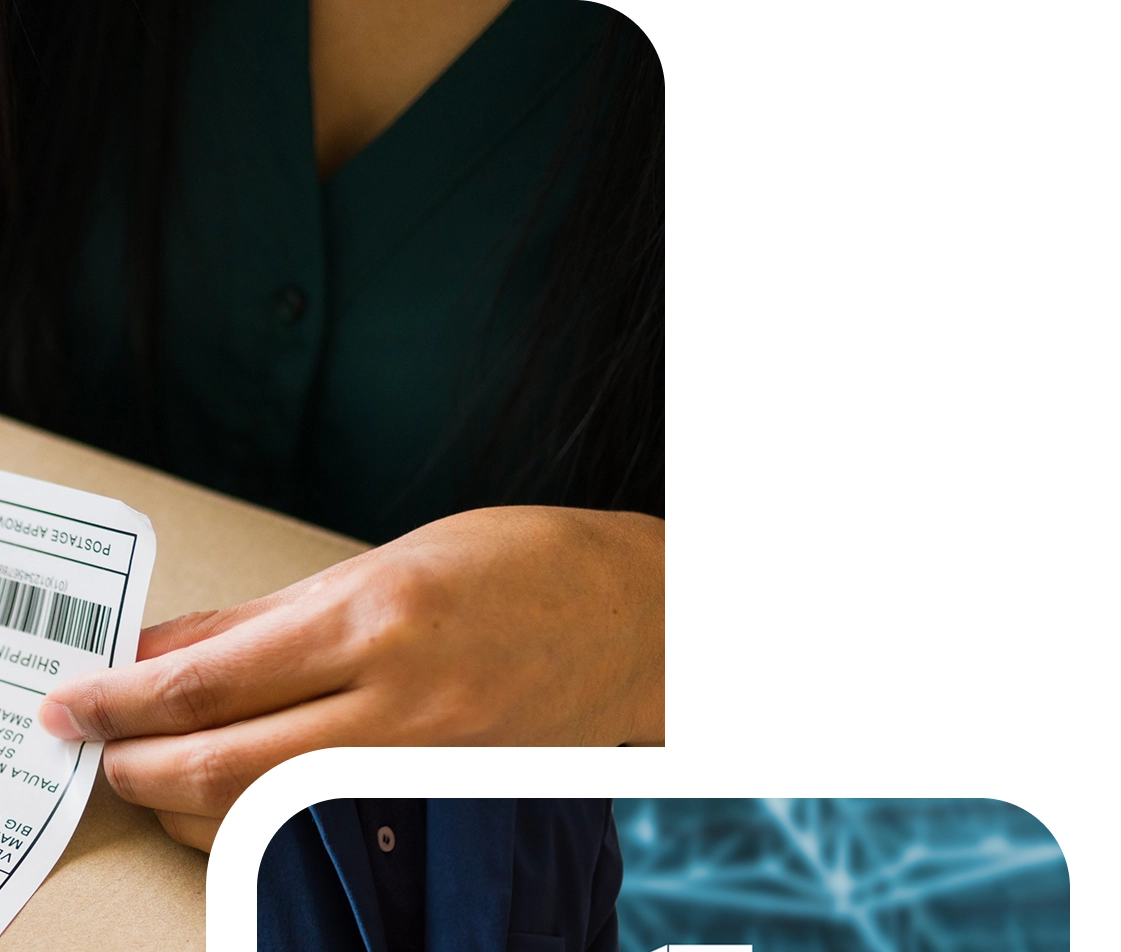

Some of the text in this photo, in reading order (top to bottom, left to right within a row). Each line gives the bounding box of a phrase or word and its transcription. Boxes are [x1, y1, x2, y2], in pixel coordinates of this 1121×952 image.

[51, 528, 111, 555] POSTAGE
[12, 768, 59, 793] PAULA
[4, 819, 33, 837] BIG
